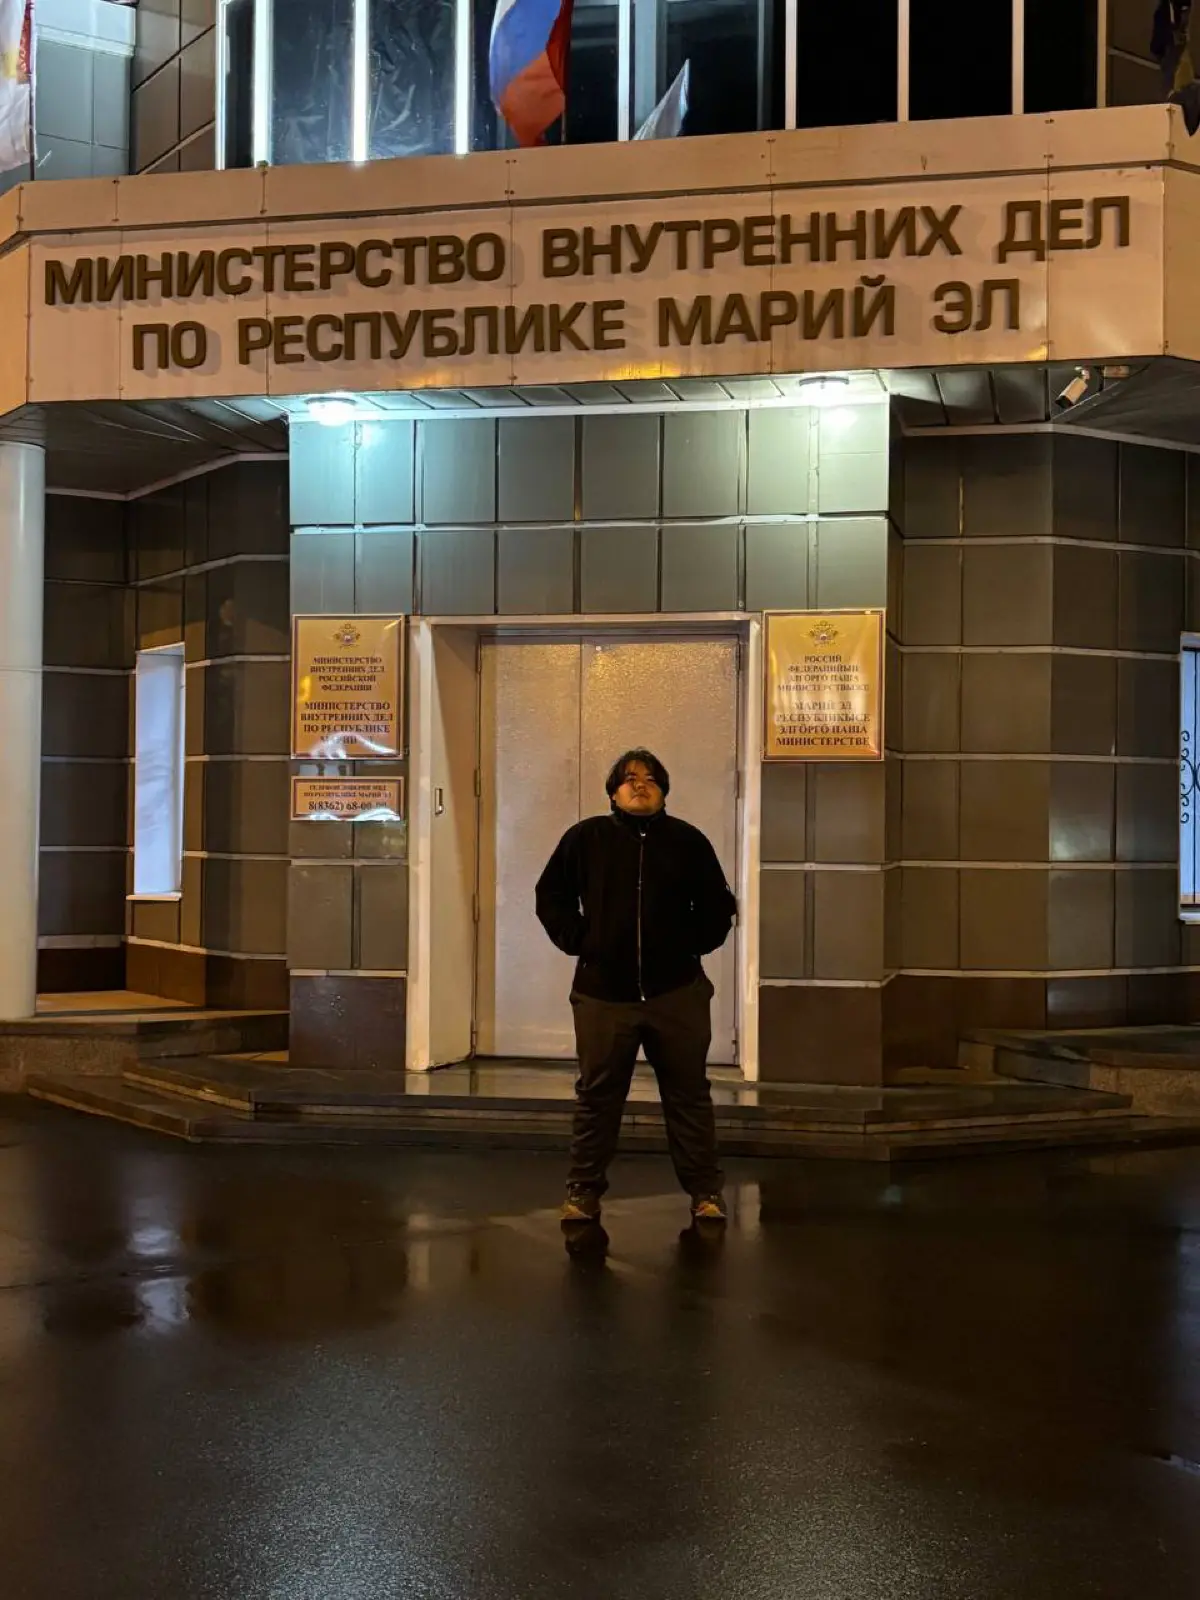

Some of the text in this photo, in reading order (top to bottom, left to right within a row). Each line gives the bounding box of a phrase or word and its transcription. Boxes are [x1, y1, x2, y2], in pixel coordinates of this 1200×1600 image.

[44, 195, 1130, 306] МИНИСТЕРСТВО ВНУТРЕННИХ ДЕЛ
[132, 274, 1020, 371] ПО РЕСПУБЛИКЕ МАРИЙ ЭЛ
[304, 701, 391, 711] МИНИСТЕРСТВО
[300, 713, 394, 722] ВНУТРЕННИХ ДЕЛ
[303, 724, 391, 733] ПО РЕСПУБЛИКЕ
[831, 725, 868, 734] ПАША
